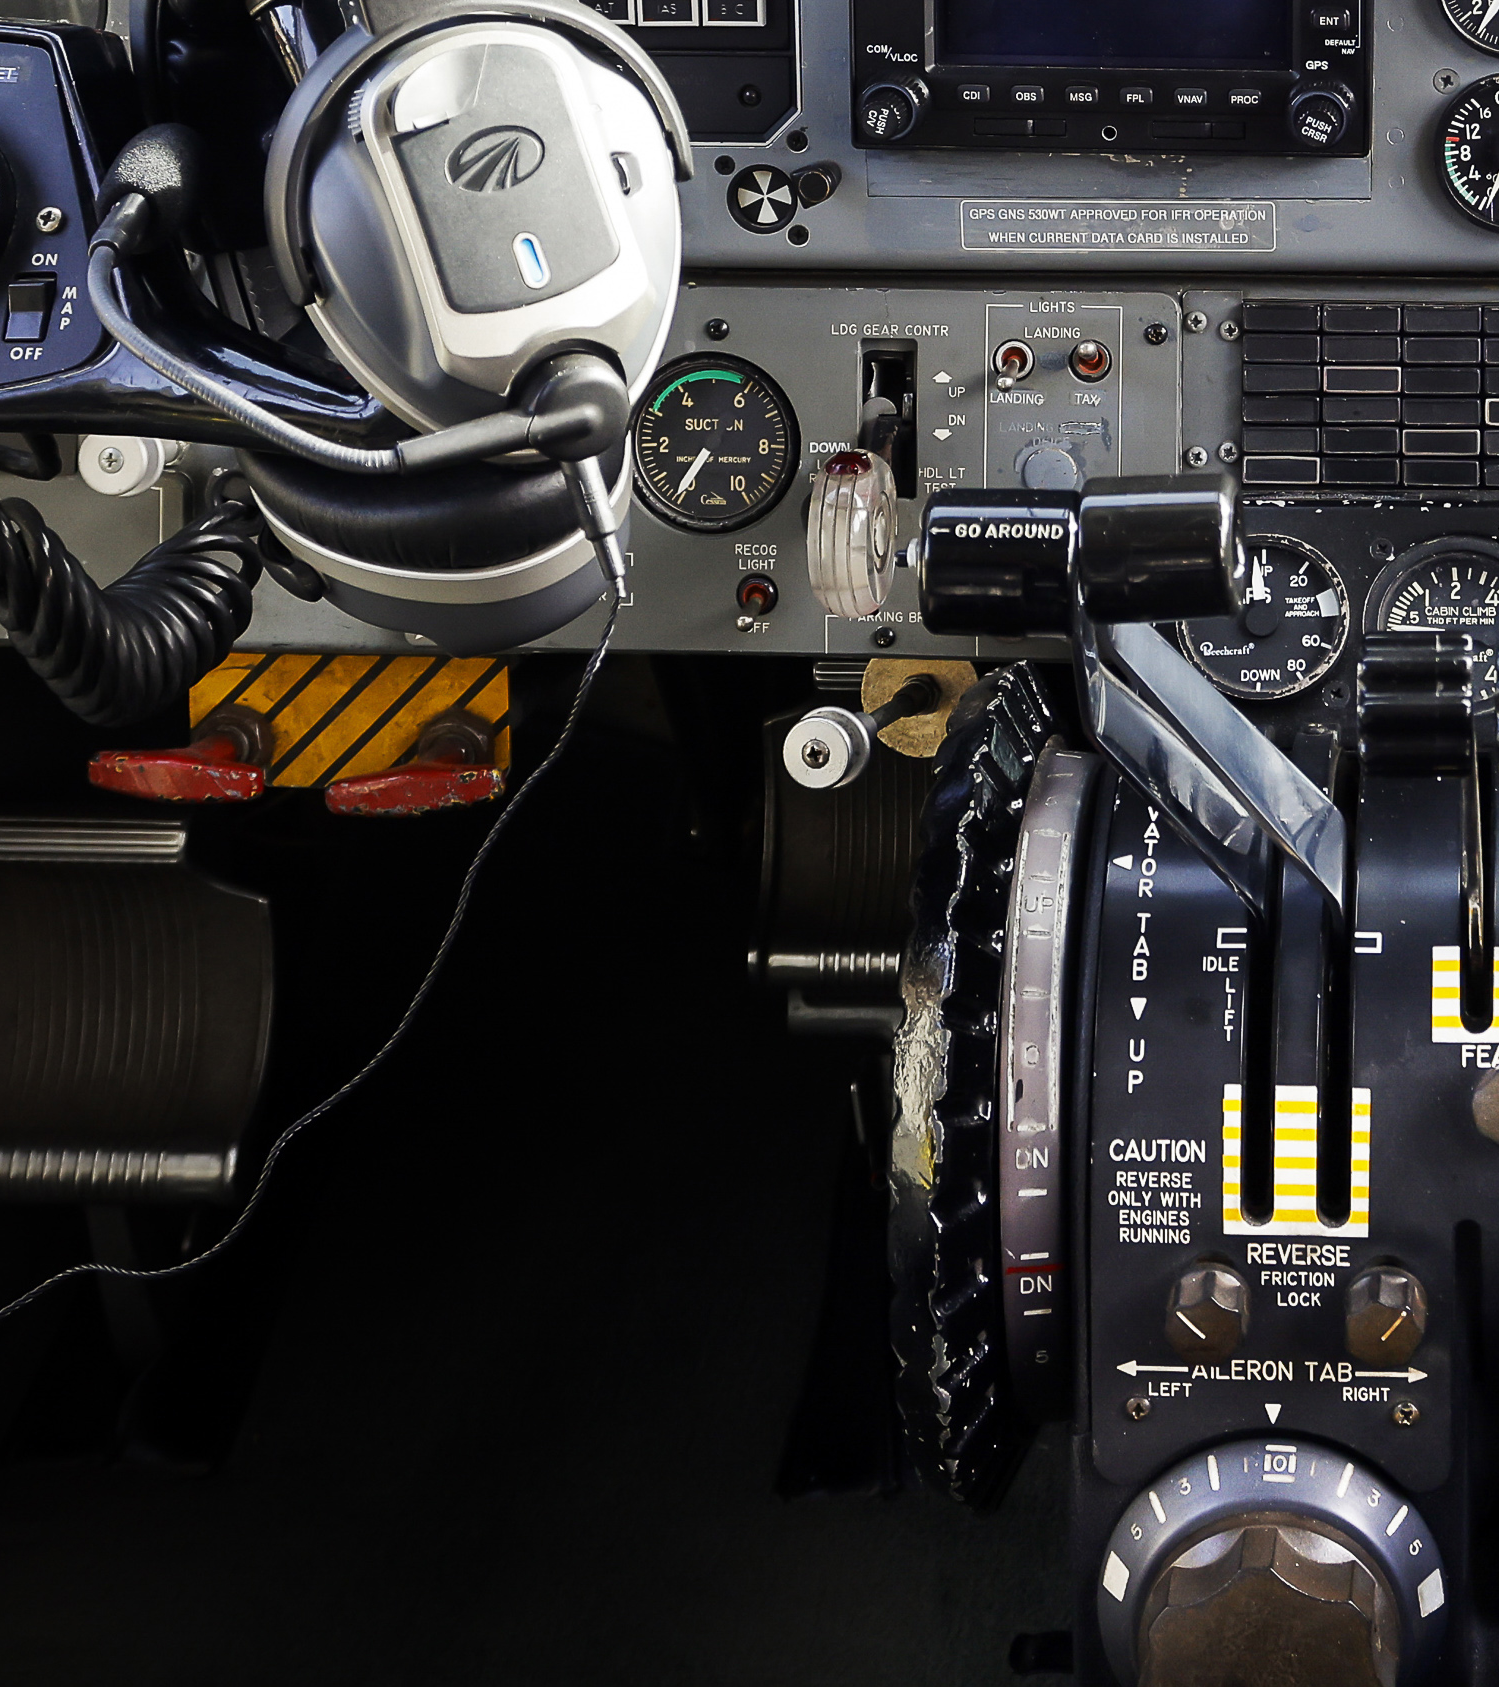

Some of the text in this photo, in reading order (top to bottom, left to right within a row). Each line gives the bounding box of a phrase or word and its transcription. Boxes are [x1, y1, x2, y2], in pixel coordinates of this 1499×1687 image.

[1319, 16, 1340, 26] ENT
[1305, 60, 1329, 71] GPS
[1015, 91, 1038, 102] OBS
[1069, 91, 1093, 102] MSG
[1230, 94, 1259, 106] PROC
[969, 209, 1266, 221] GPS GNS 530WT APPROVED FOR IFR OPERATION
[989, 232, 1248, 244] WHEN CURRENT DATA CARD IS INSTALLED
[1028, 301, 1075, 313] LIGHTS
[831, 324, 949, 337] LDG GEAR CONTR
[1024, 326, 1081, 340] LANDING
[809, 442, 850, 454] DOWN
[955, 522, 1063, 540] GO AROUND
[734, 544, 778, 557] RECOG
[738, 558, 775, 572] LIGHT
[1109, 1139, 1206, 1163] CAUTION
[1115, 1171, 1193, 1189] REVERSE
[1119, 1209, 1190, 1227] ENGINES
[1119, 1227, 1191, 1245] RUNNING
[1247, 1243, 1351, 1267] REVERSE
[1304, 1360, 1354, 1384] TAB
